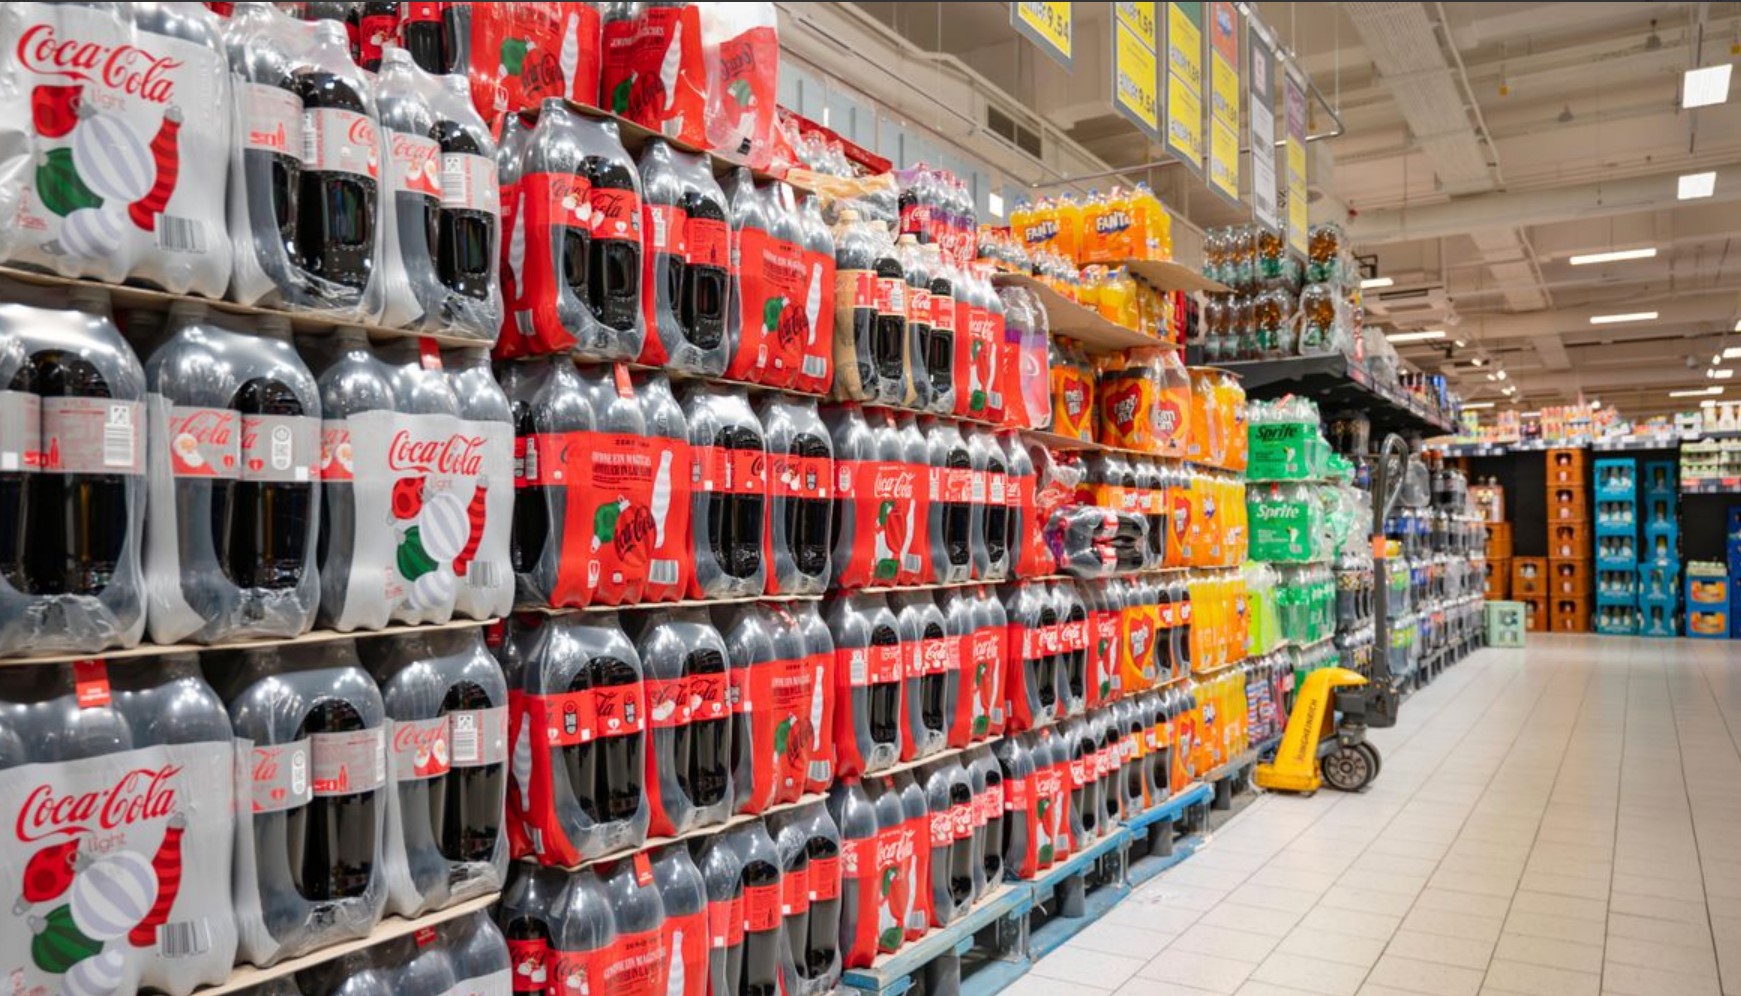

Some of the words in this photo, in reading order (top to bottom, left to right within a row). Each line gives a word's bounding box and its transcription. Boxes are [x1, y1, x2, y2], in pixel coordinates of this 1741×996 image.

[16, 24, 185, 103] Coca-Cola
[388, 430, 488, 476] Coca-Cola
[1255, 424, 1298, 442] Sprite
[874, 471, 915, 499] Coca-Cola
[1256, 504, 1300, 521] Sprite
[16, 764, 184, 842] Coca-Cola
[875, 828, 916, 870] Coca-Cola
